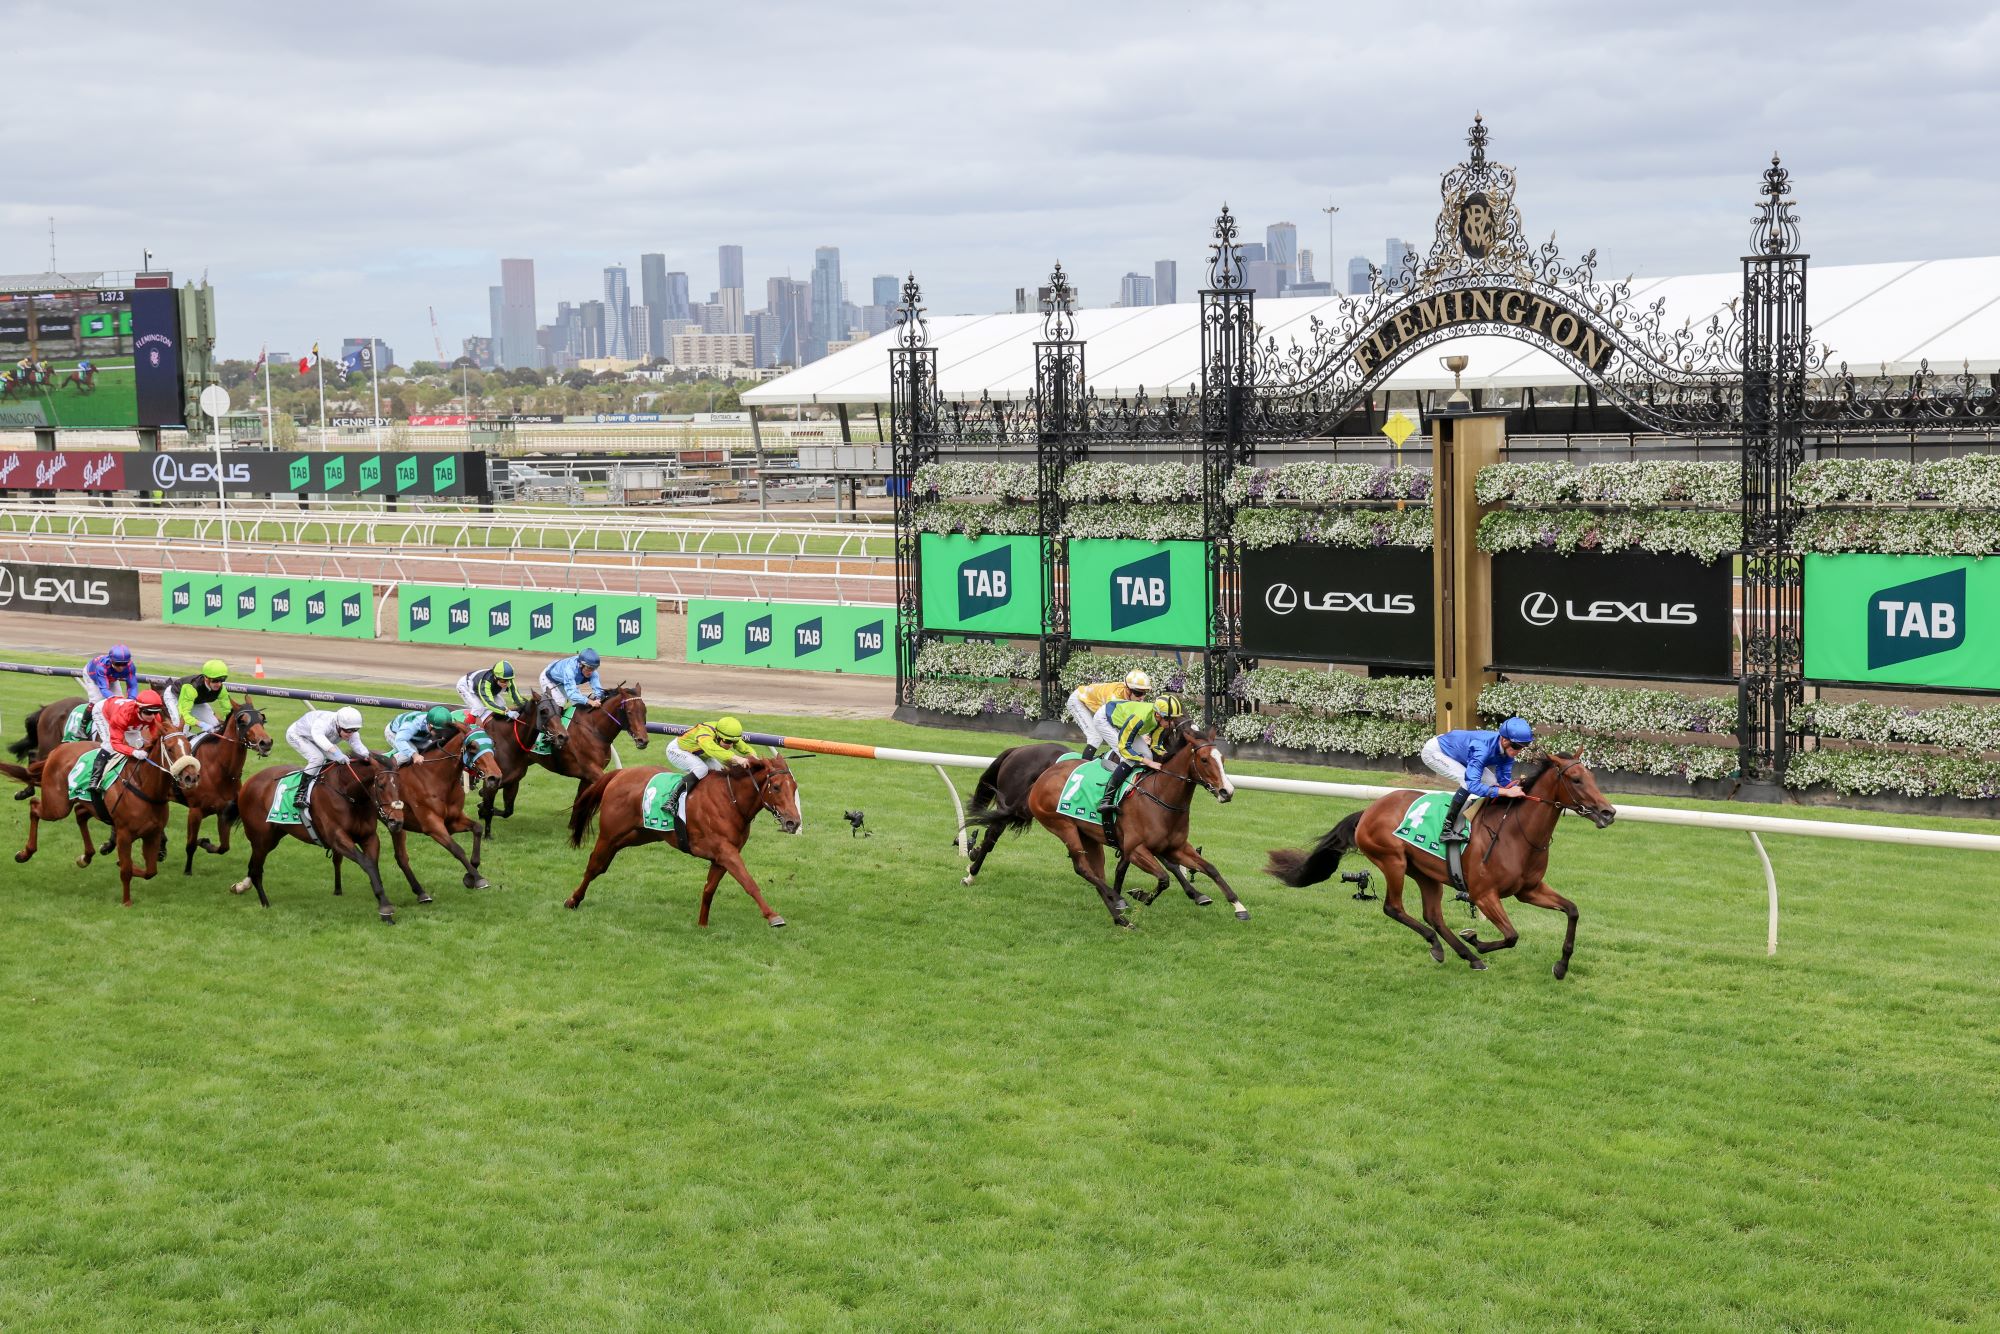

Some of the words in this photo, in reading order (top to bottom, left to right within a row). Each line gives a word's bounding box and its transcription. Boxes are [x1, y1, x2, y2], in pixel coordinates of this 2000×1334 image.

[100, 291, 124, 302] 1:37.3
[135, 333, 173, 349] FLEMINGTON
[1354, 289, 1610, 376] FLEMINGTON
[333, 418, 390, 427] KENNEDY
[35, 452, 67, 488] Penfolds
[83, 452, 115, 488] Penfolds
[178, 463, 250, 482] LEXUS
[291, 466, 307, 480] TAB
[326, 466, 343, 480] TAB
[361, 466, 379, 480] TAB
[398, 467, 415, 480] TAB
[435, 467, 453, 481] TAB
[18, 575, 110, 606] LEXUS
[963, 568, 1007, 598] TAB
[1117, 575, 1165, 607] TAB
[174, 591, 189, 605] TAB
[206, 593, 222, 607] TAB
[238, 595, 255, 610] TAB
[273, 598, 289, 613] TAB
[307, 600, 325, 615] TAB
[343, 602, 360, 617] TAB
[1303, 590, 1415, 615] LEXUS
[1565, 600, 1697, 625] LEXUS
[412, 606, 430, 621] TAB
[450, 608, 469, 623] TAB
[490, 611, 510, 626] TAB
[532, 613, 552, 629] TAB
[575, 616, 595, 632] TAB
[619, 618, 640, 635] TAB
[1878, 600, 1956, 639] TAB
[700, 623, 722, 640] TAB
[747, 626, 770, 643] TAB
[797, 629, 820, 646] TAB
[857, 632, 881, 649] TAB
[1063, 773, 1084, 801] 7
[1408, 801, 1431, 829] 4
